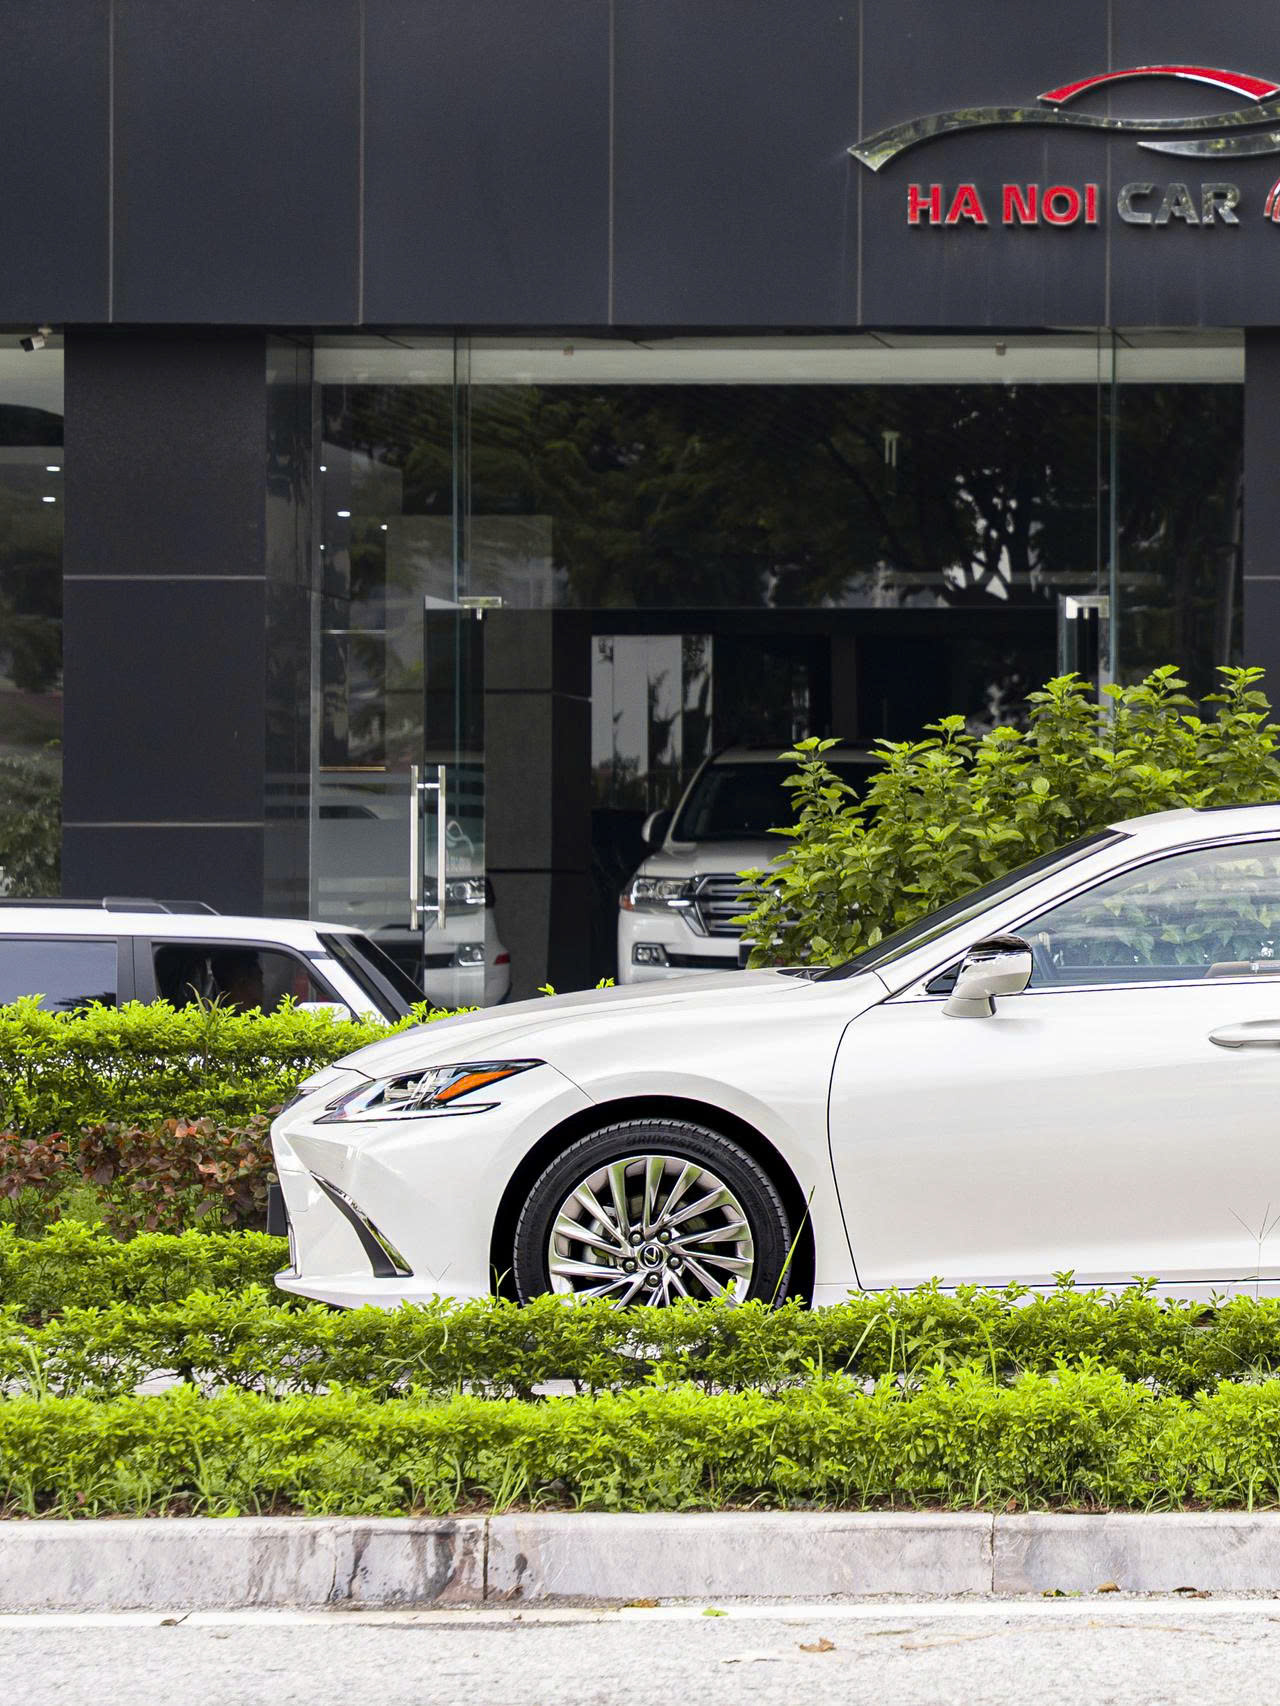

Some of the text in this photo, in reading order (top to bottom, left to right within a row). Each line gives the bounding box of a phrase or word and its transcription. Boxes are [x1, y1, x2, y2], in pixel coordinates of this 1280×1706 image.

[907, 182, 1240, 225] HA NOI CAR
